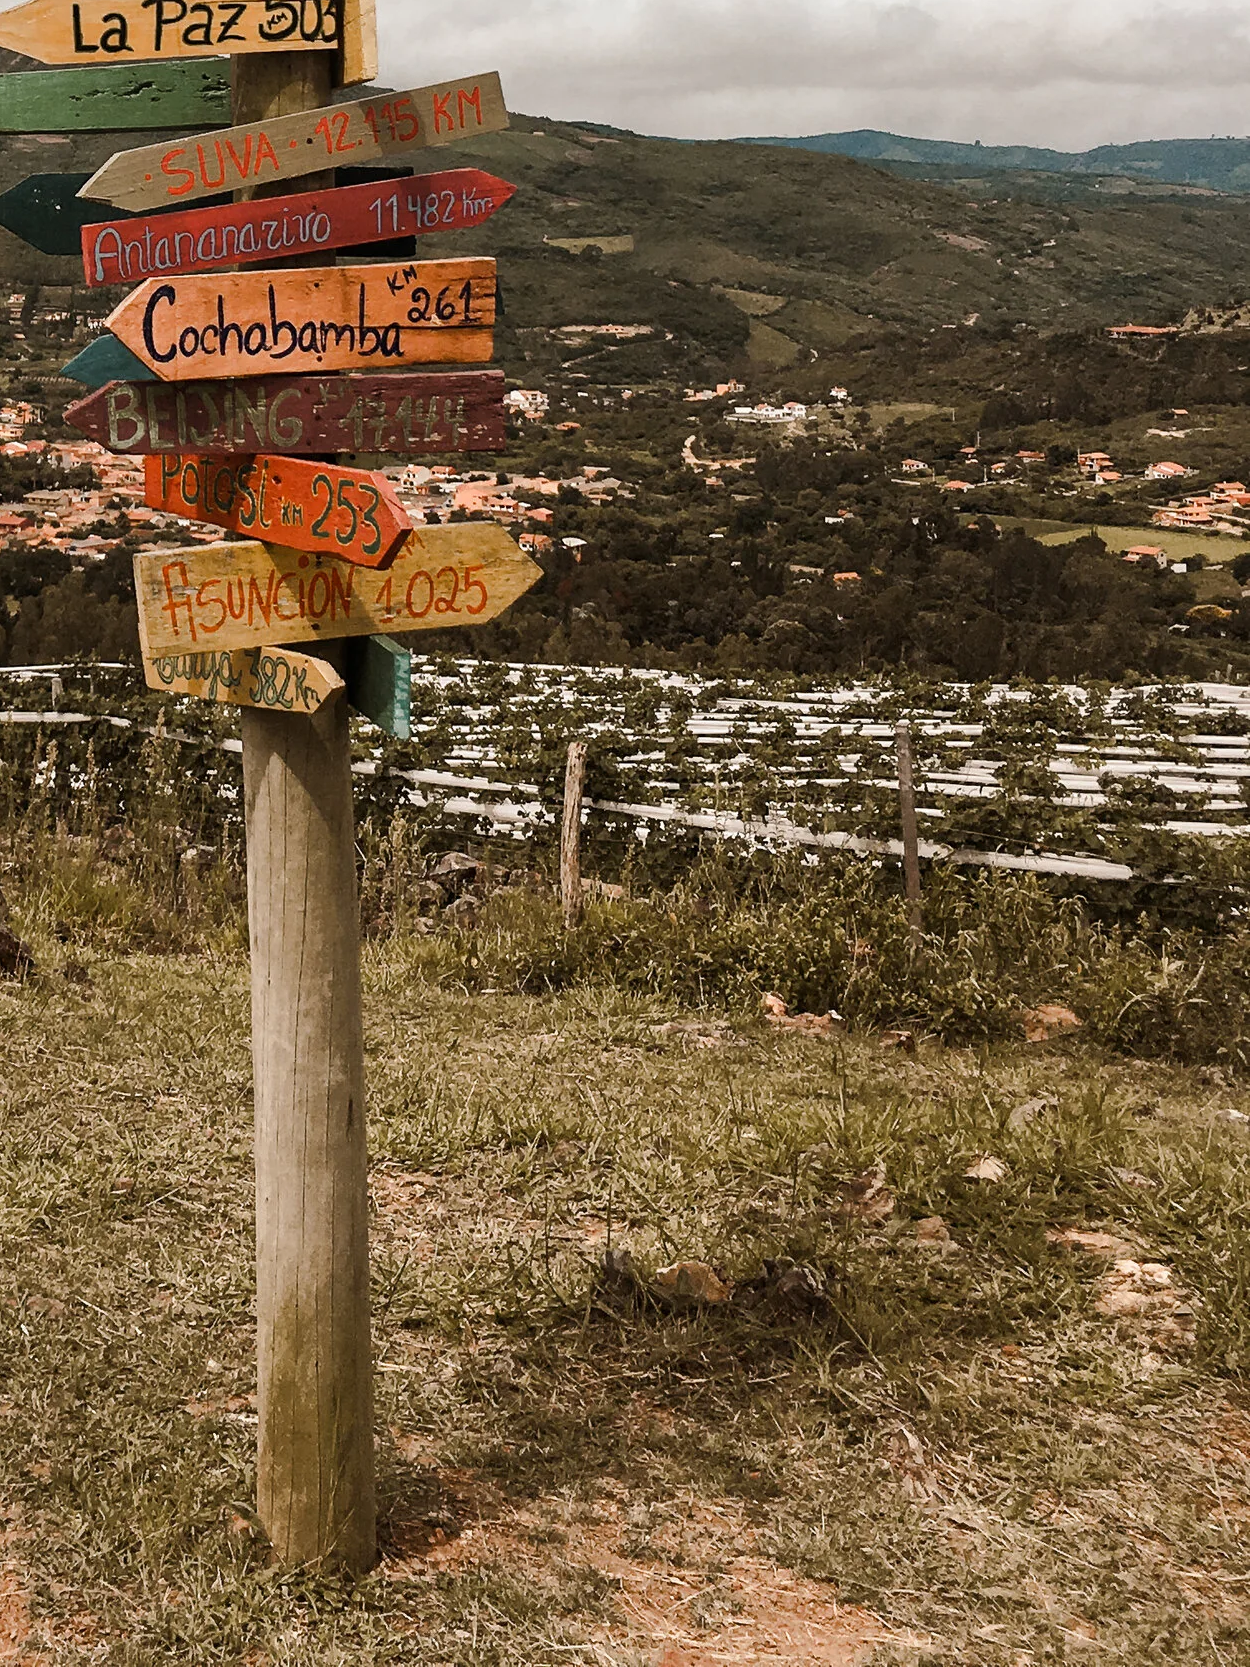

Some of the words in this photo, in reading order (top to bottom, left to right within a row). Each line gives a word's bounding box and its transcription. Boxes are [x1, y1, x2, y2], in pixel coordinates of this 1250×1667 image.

[71, 2, 135, 55] La
[159, 133, 280, 196] SUVA
[432, 85, 483, 135] KM
[368, 189, 456, 235] 11.482
[142, 281, 406, 364] Cochabamba
[385, 263, 418, 297] KM
[406, 280, 481, 324] 261
[310, 472, 383, 556] 253
[375, 562, 488, 624] 1.025
